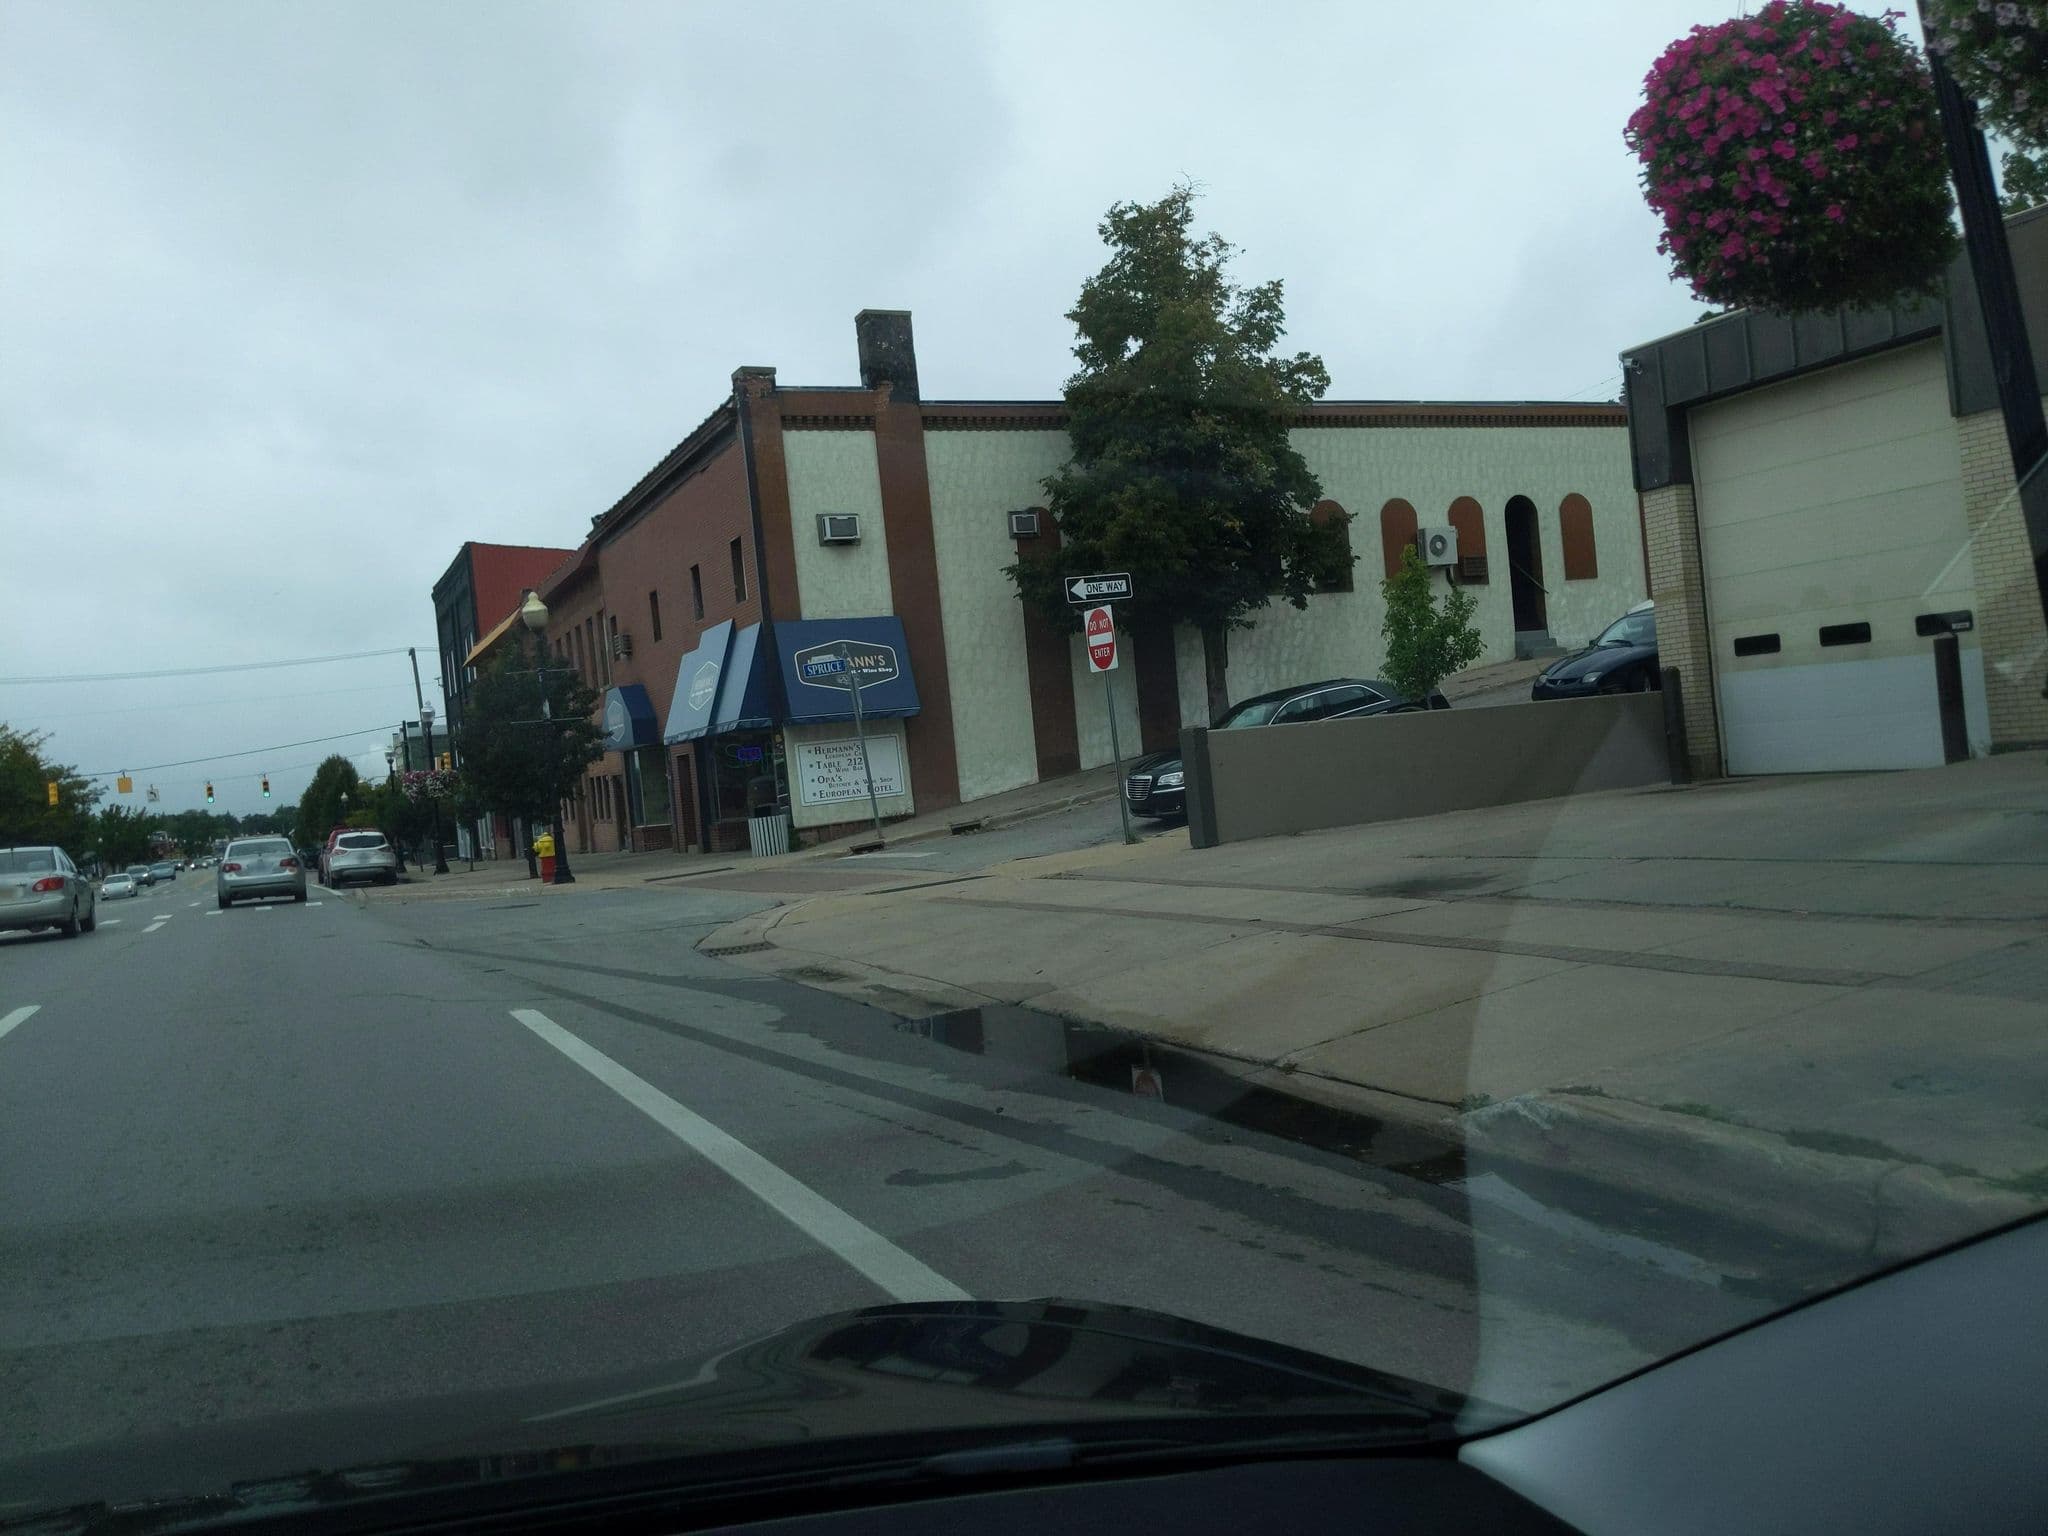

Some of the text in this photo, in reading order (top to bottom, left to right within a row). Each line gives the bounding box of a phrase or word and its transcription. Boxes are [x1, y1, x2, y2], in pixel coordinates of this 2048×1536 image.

[1086, 581, 1124, 593] ONE WAY
[1089, 618, 1109, 631] DO NOT
[1094, 647, 1110, 658] ENTER
[807, 661, 842, 675] SPRUCE
[847, 757, 863, 766] 212
[819, 788, 862, 798] EUROPEAN
